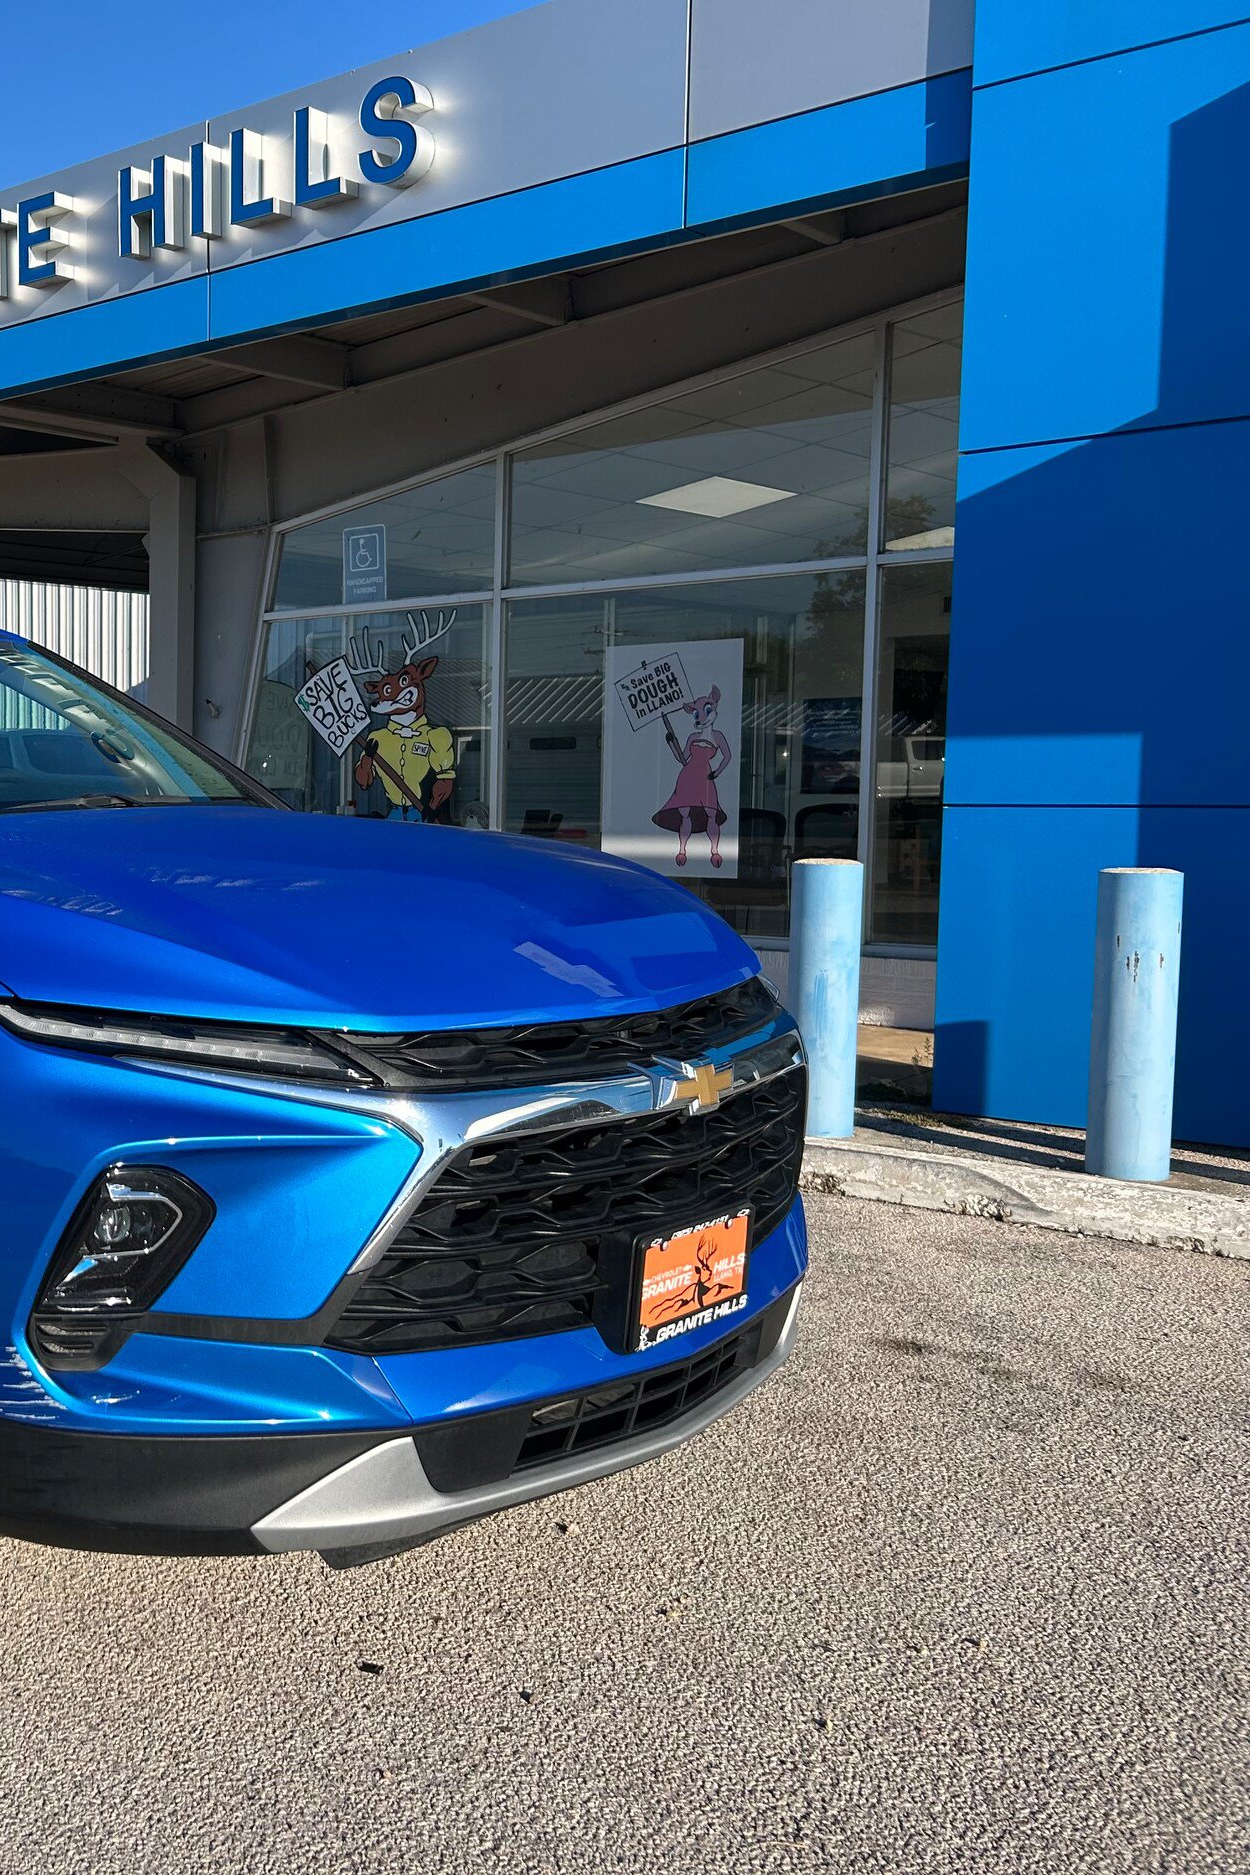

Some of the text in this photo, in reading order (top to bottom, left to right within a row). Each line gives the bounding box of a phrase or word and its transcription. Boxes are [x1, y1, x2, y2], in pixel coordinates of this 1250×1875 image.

[117, 76, 433, 260] HILLS
[346, 576, 384, 586] HANDICAPPED
[353, 585, 377, 596] PARKING
[305, 662, 348, 707] SAVE
[627, 671, 679, 710] DOUGH
[630, 662, 671, 689] Save BIG
[312, 686, 354, 730] BIG
[635, 687, 684, 719] in LLANO!
[327, 703, 368, 749] BUCKS
[641, 1252, 746, 1300] GRANITE HILLS
[650, 1266, 683, 1283] CHEVROLET
[656, 1294, 748, 1343] GRANITE HILLS
